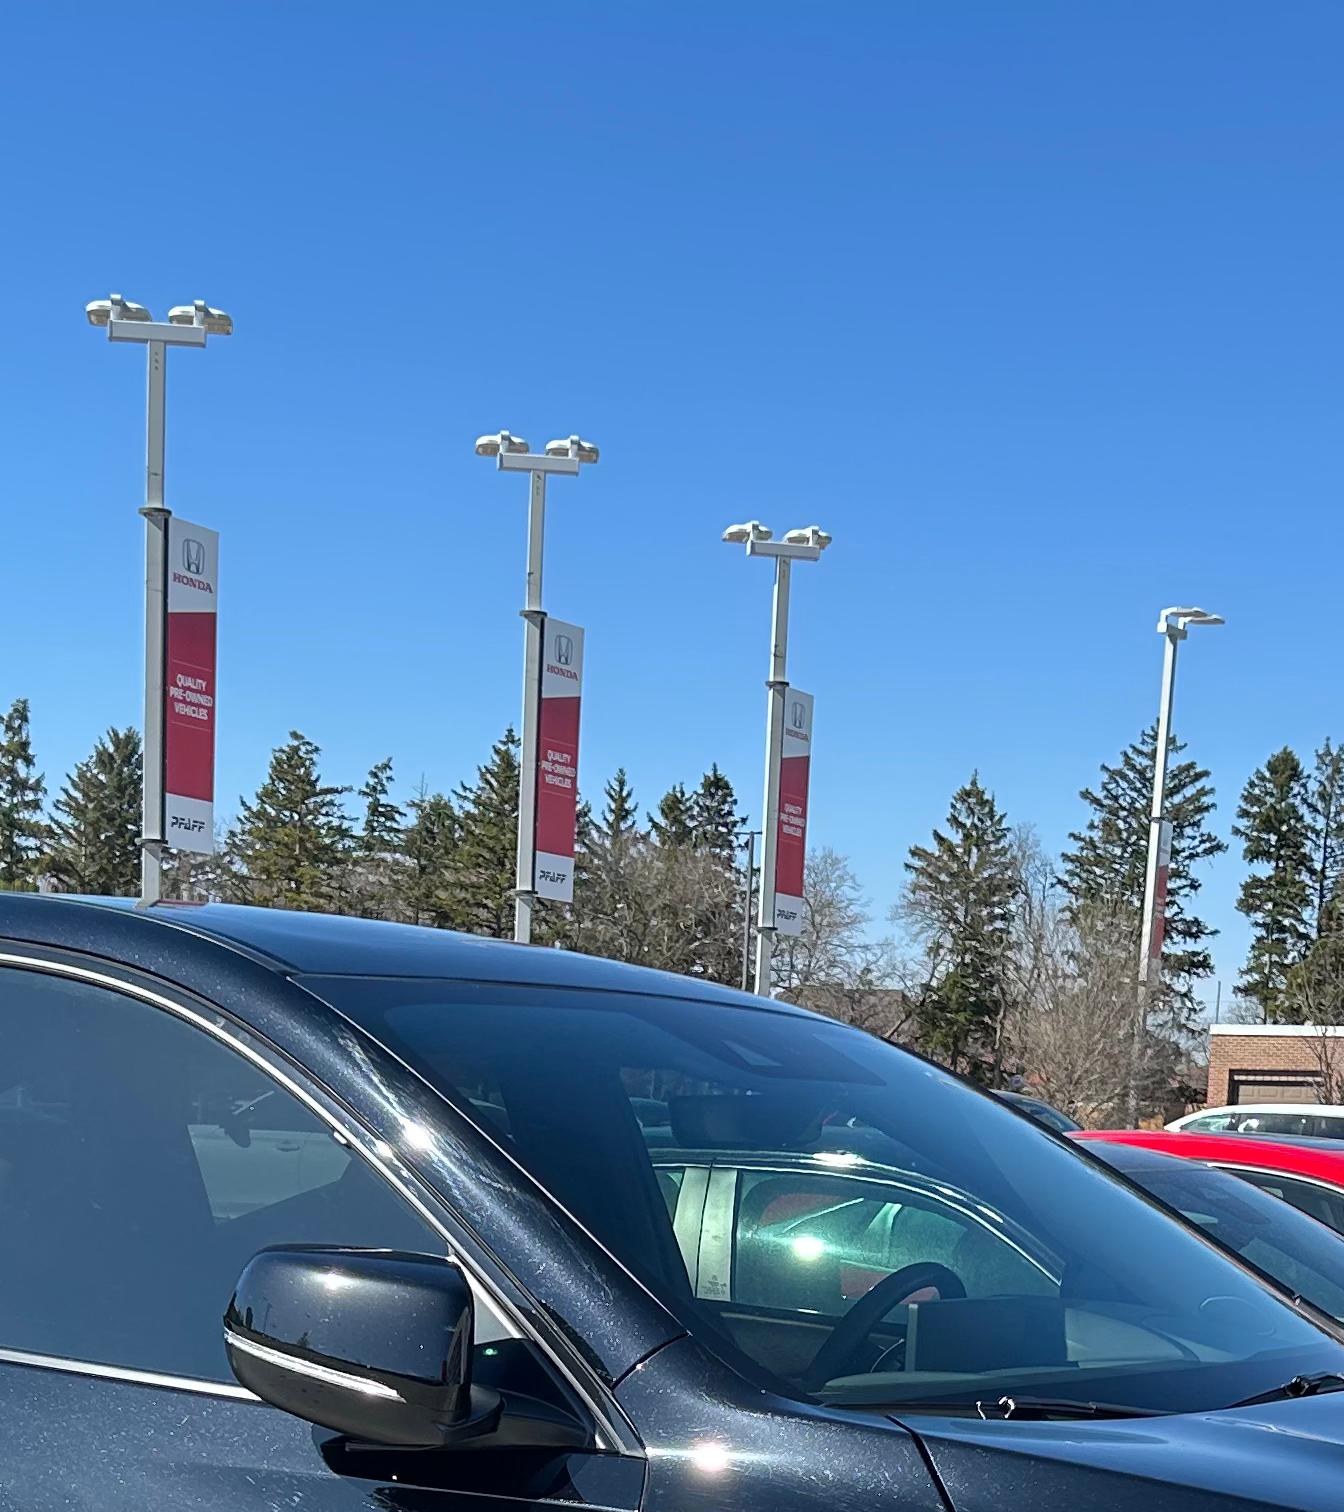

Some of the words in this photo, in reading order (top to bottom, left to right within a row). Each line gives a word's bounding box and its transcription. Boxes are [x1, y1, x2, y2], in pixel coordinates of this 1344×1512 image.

[172, 571, 214, 594] HONDA
[546, 663, 579, 682] HONDA
[176, 673, 207, 692] QUALITY
[174, 702, 208, 720] VEHICLES
[170, 815, 206, 832] PFAFF
